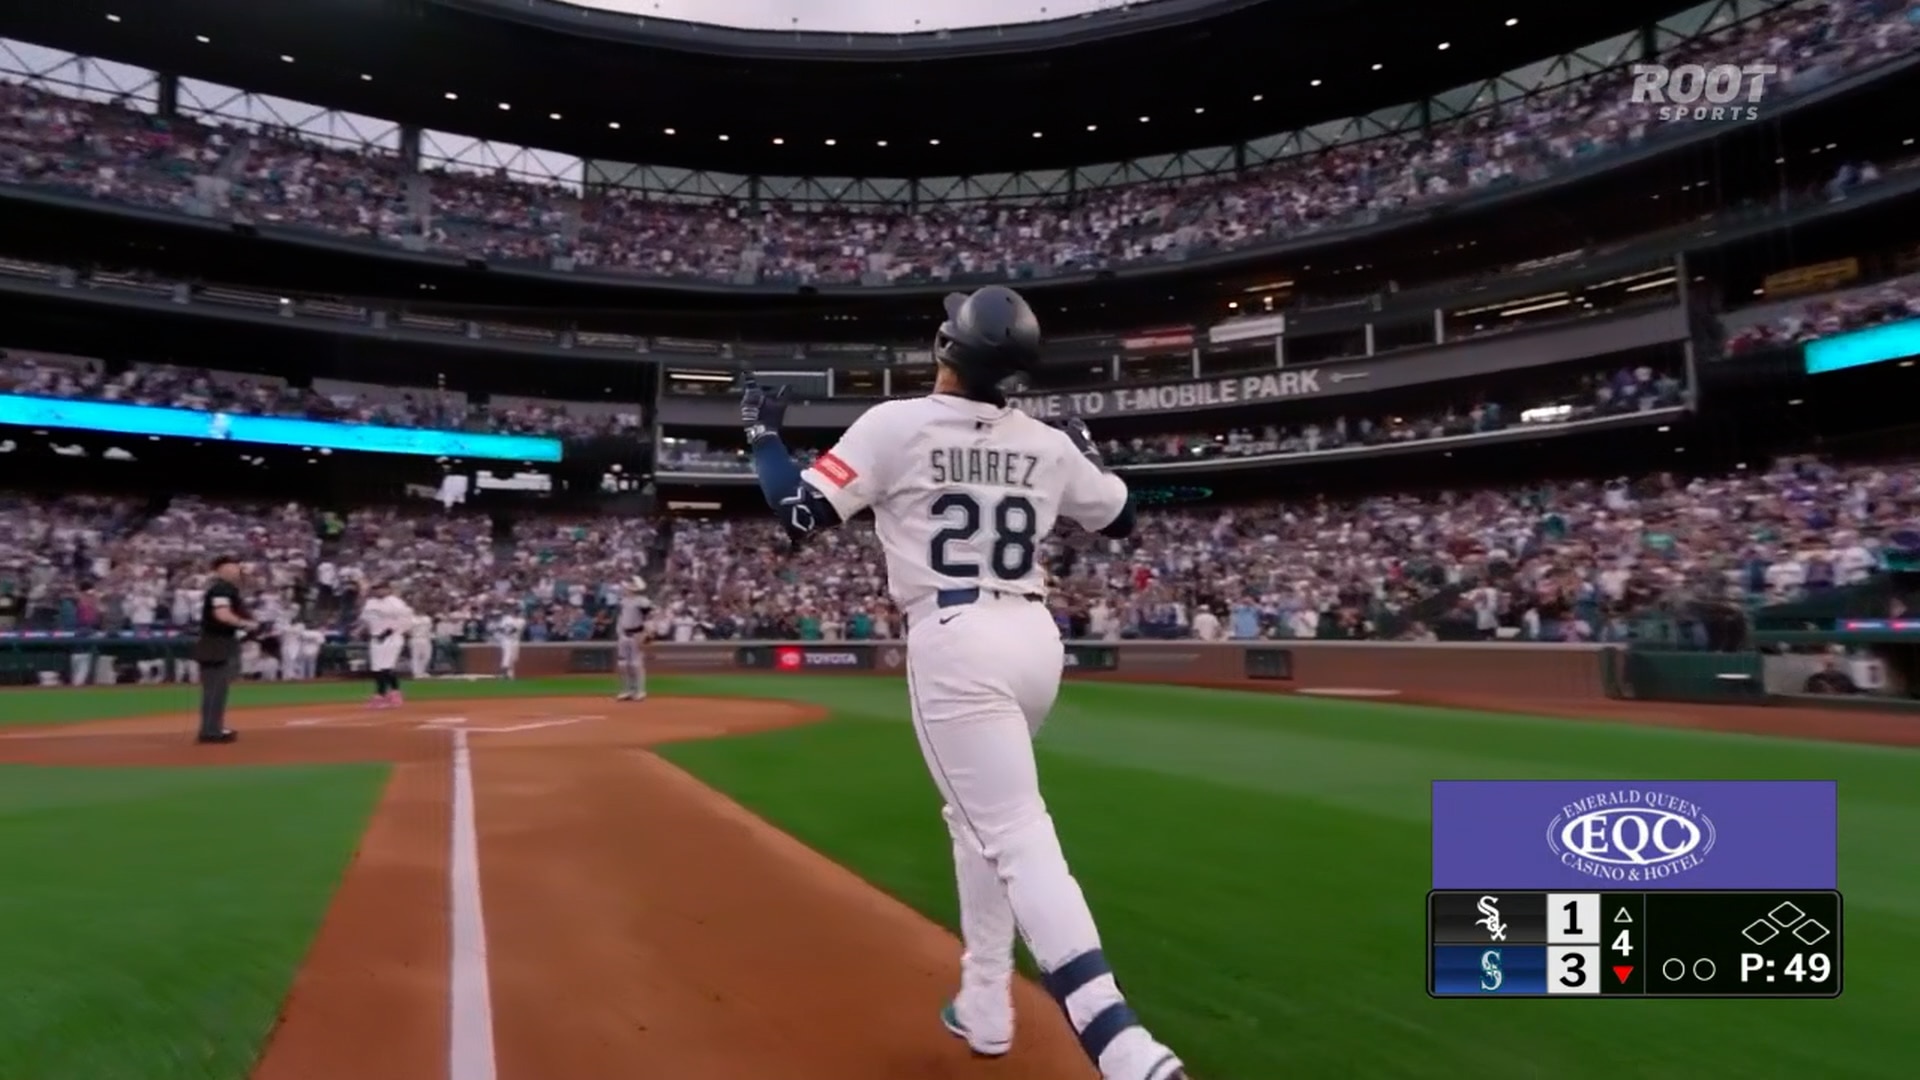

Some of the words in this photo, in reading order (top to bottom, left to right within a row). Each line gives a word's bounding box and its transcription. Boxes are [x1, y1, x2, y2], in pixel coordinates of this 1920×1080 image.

[1070, 392, 1104, 414] TO
[1115, 379, 1238, 411] T-MOBILE
[1243, 368, 1320, 400] PARK
[930, 493, 1036, 580] 28
